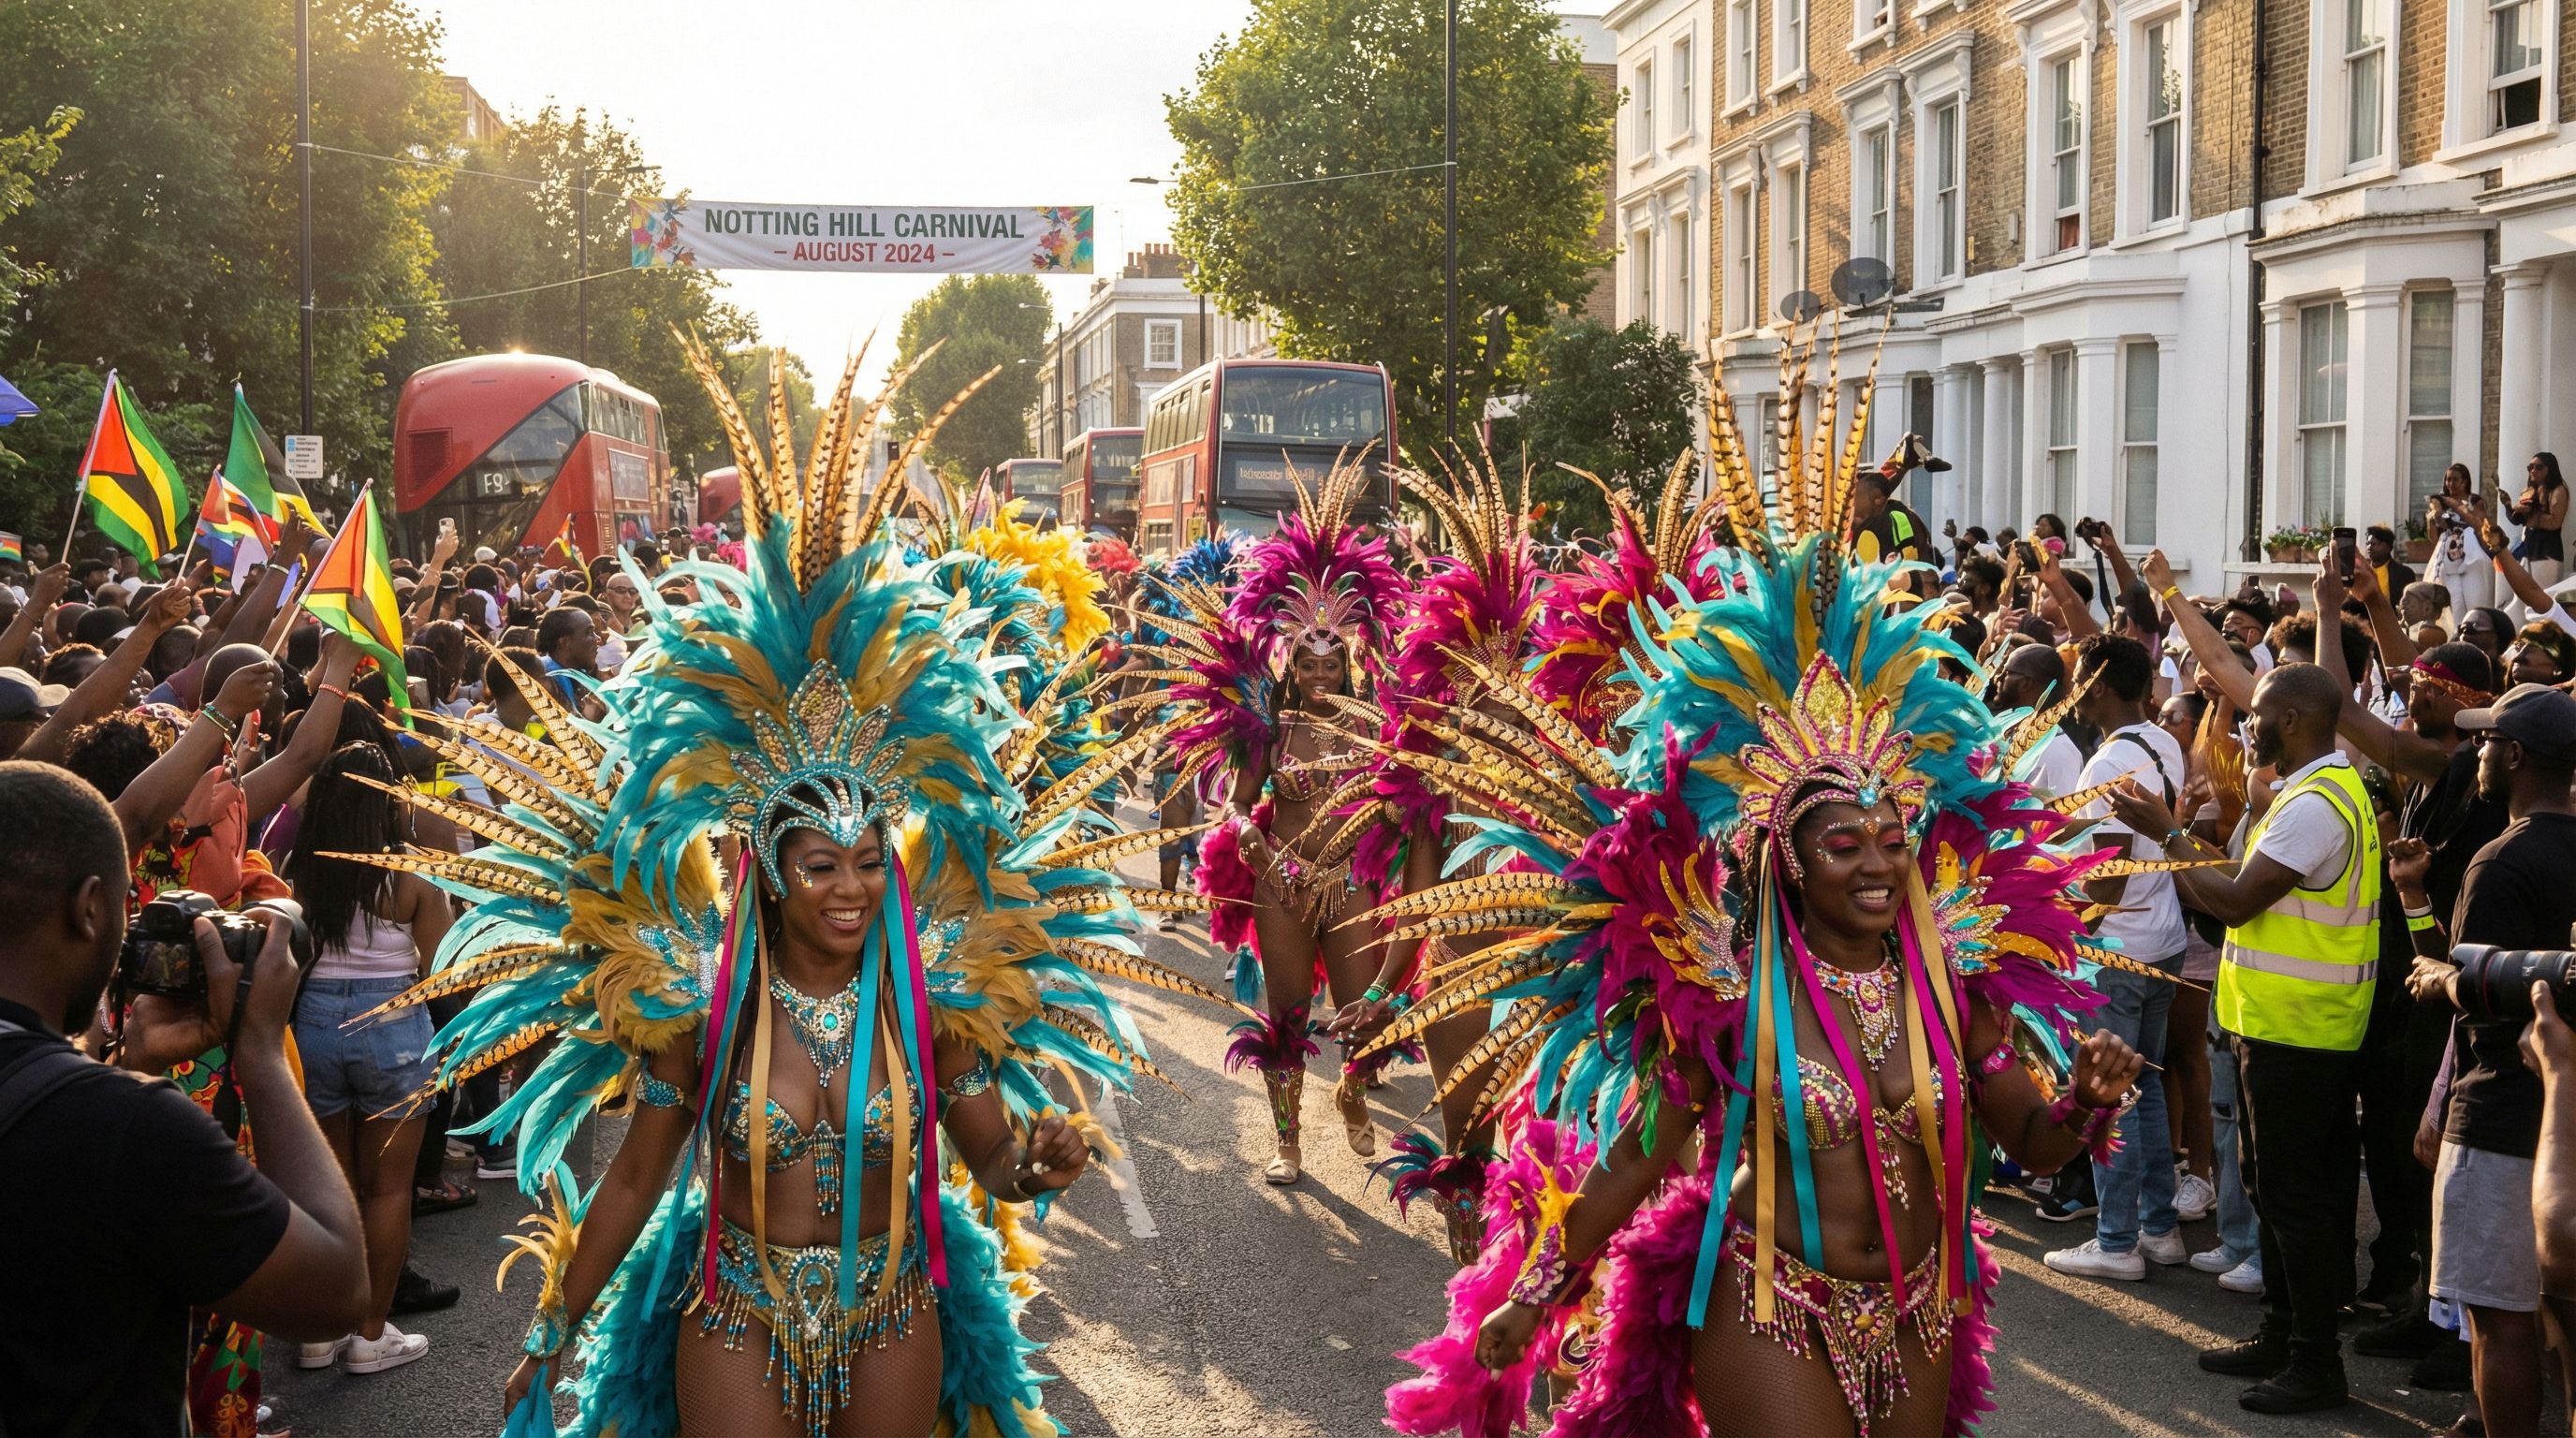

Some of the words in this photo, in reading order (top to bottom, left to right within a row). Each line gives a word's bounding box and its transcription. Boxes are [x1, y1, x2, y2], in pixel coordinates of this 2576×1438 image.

[705, 208, 820, 236] NOTTING
[829, 212, 886, 237] HILL
[894, 213, 1025, 239] CARNIVAL
[793, 242, 878, 263] AUGUST
[884, 243, 936, 263] 2024
